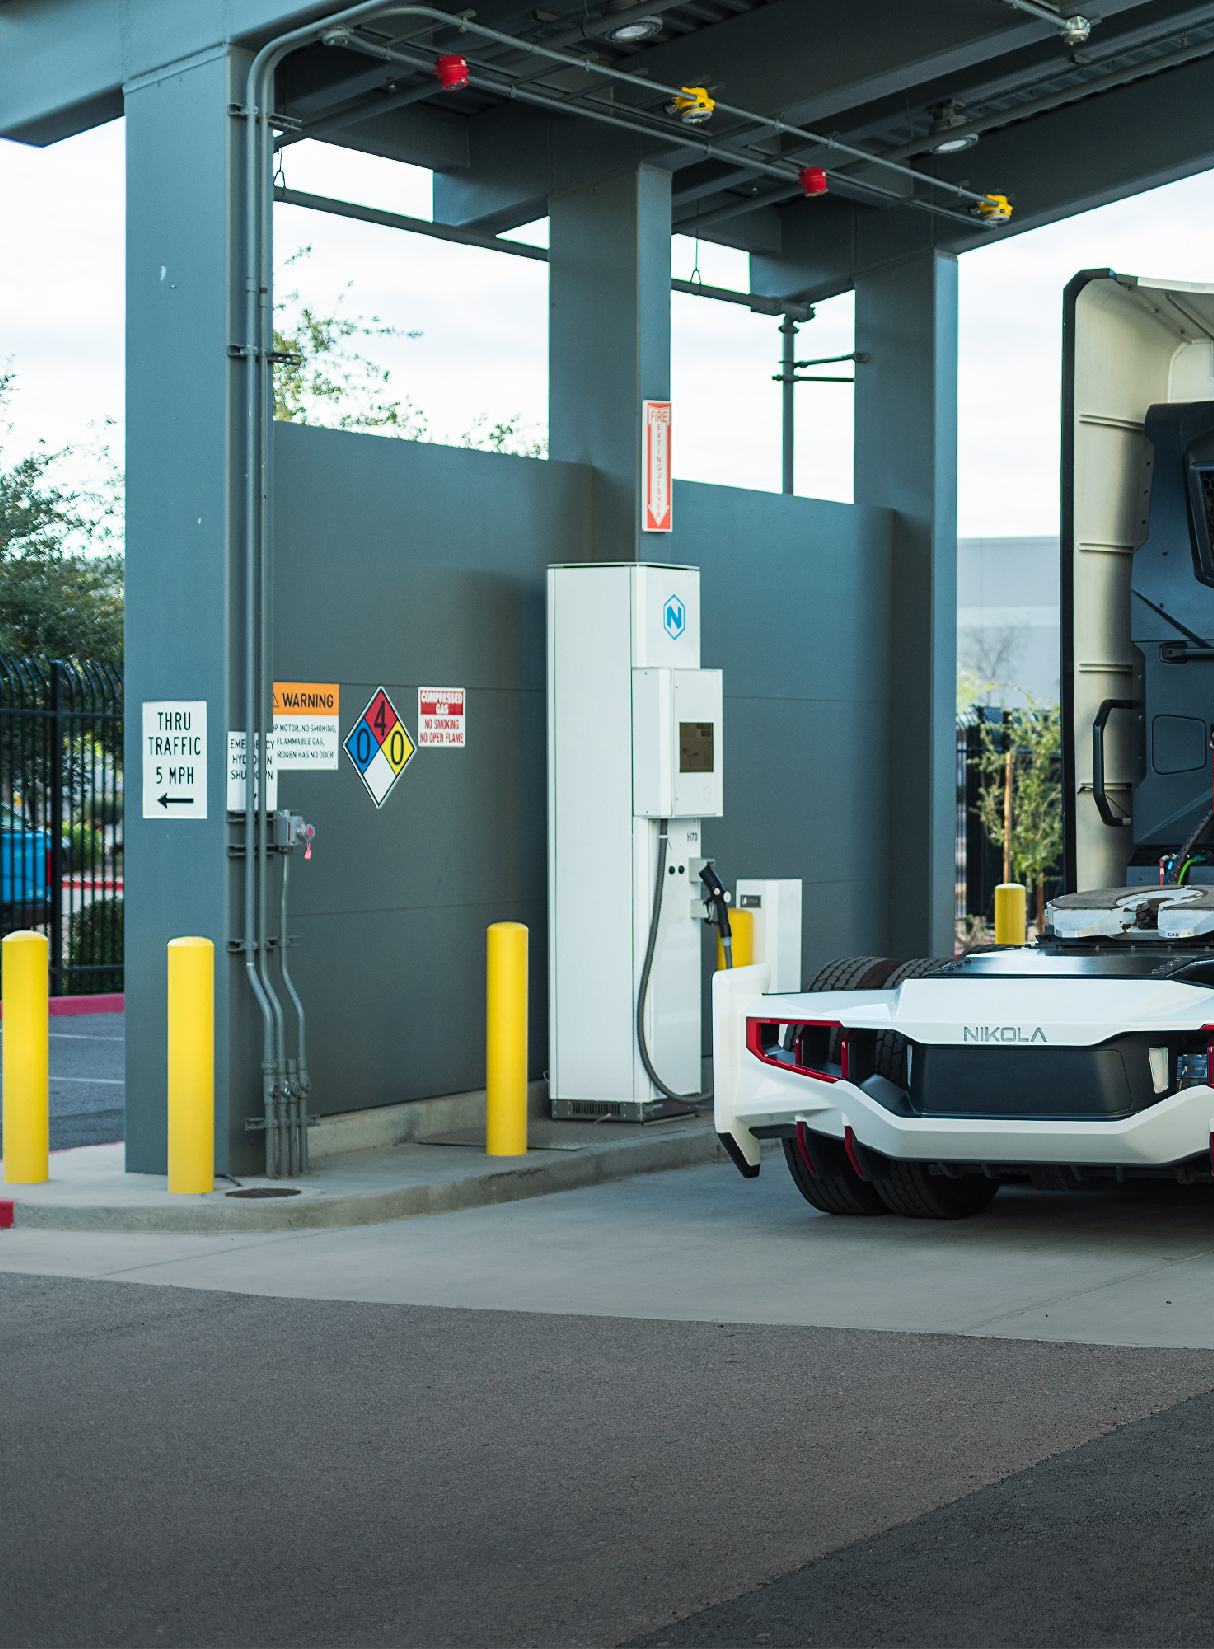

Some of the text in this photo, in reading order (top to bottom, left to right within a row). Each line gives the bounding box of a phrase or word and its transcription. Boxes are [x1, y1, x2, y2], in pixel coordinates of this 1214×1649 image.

[651, 410, 668, 423] FIRE
[282, 693, 334, 708] WARNING
[157, 711, 191, 731] THRU
[374, 701, 387, 737] 4
[424, 719, 459, 730] NO SMOKING
[148, 737, 201, 756] TRAFFIC
[356, 728, 370, 764] 0
[419, 732, 464, 744] NO OPEN FLAME
[390, 730, 404, 765] 0
[156, 767, 195, 785] 5 MPH
[963, 1026, 1047, 1043] NIKOLA
